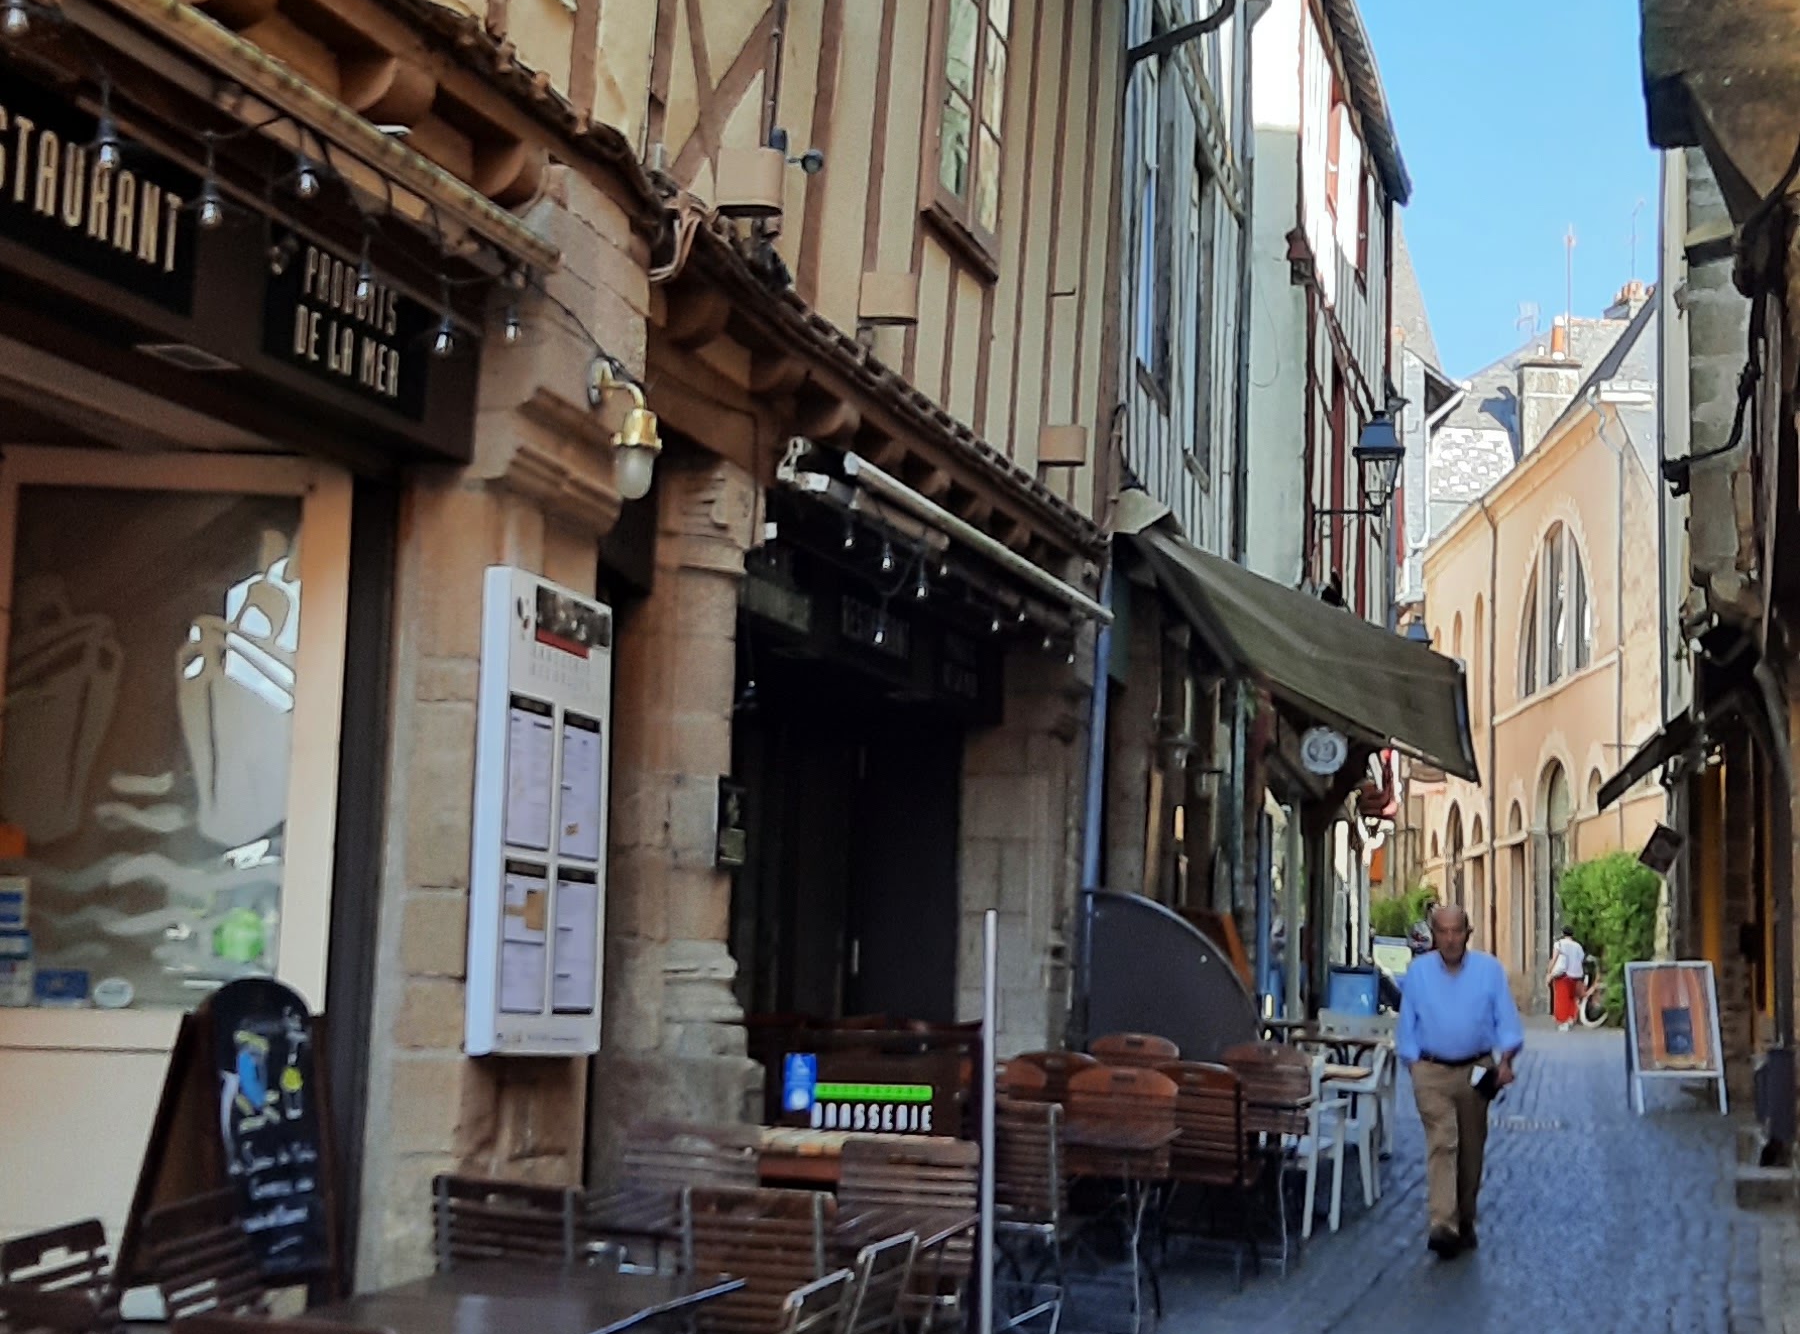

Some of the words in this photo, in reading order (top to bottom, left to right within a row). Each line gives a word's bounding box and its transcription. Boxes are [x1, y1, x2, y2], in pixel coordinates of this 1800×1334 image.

[294, 304, 322, 361] DE
[327, 320, 354, 376] LA
[360, 336, 400, 397] MER
